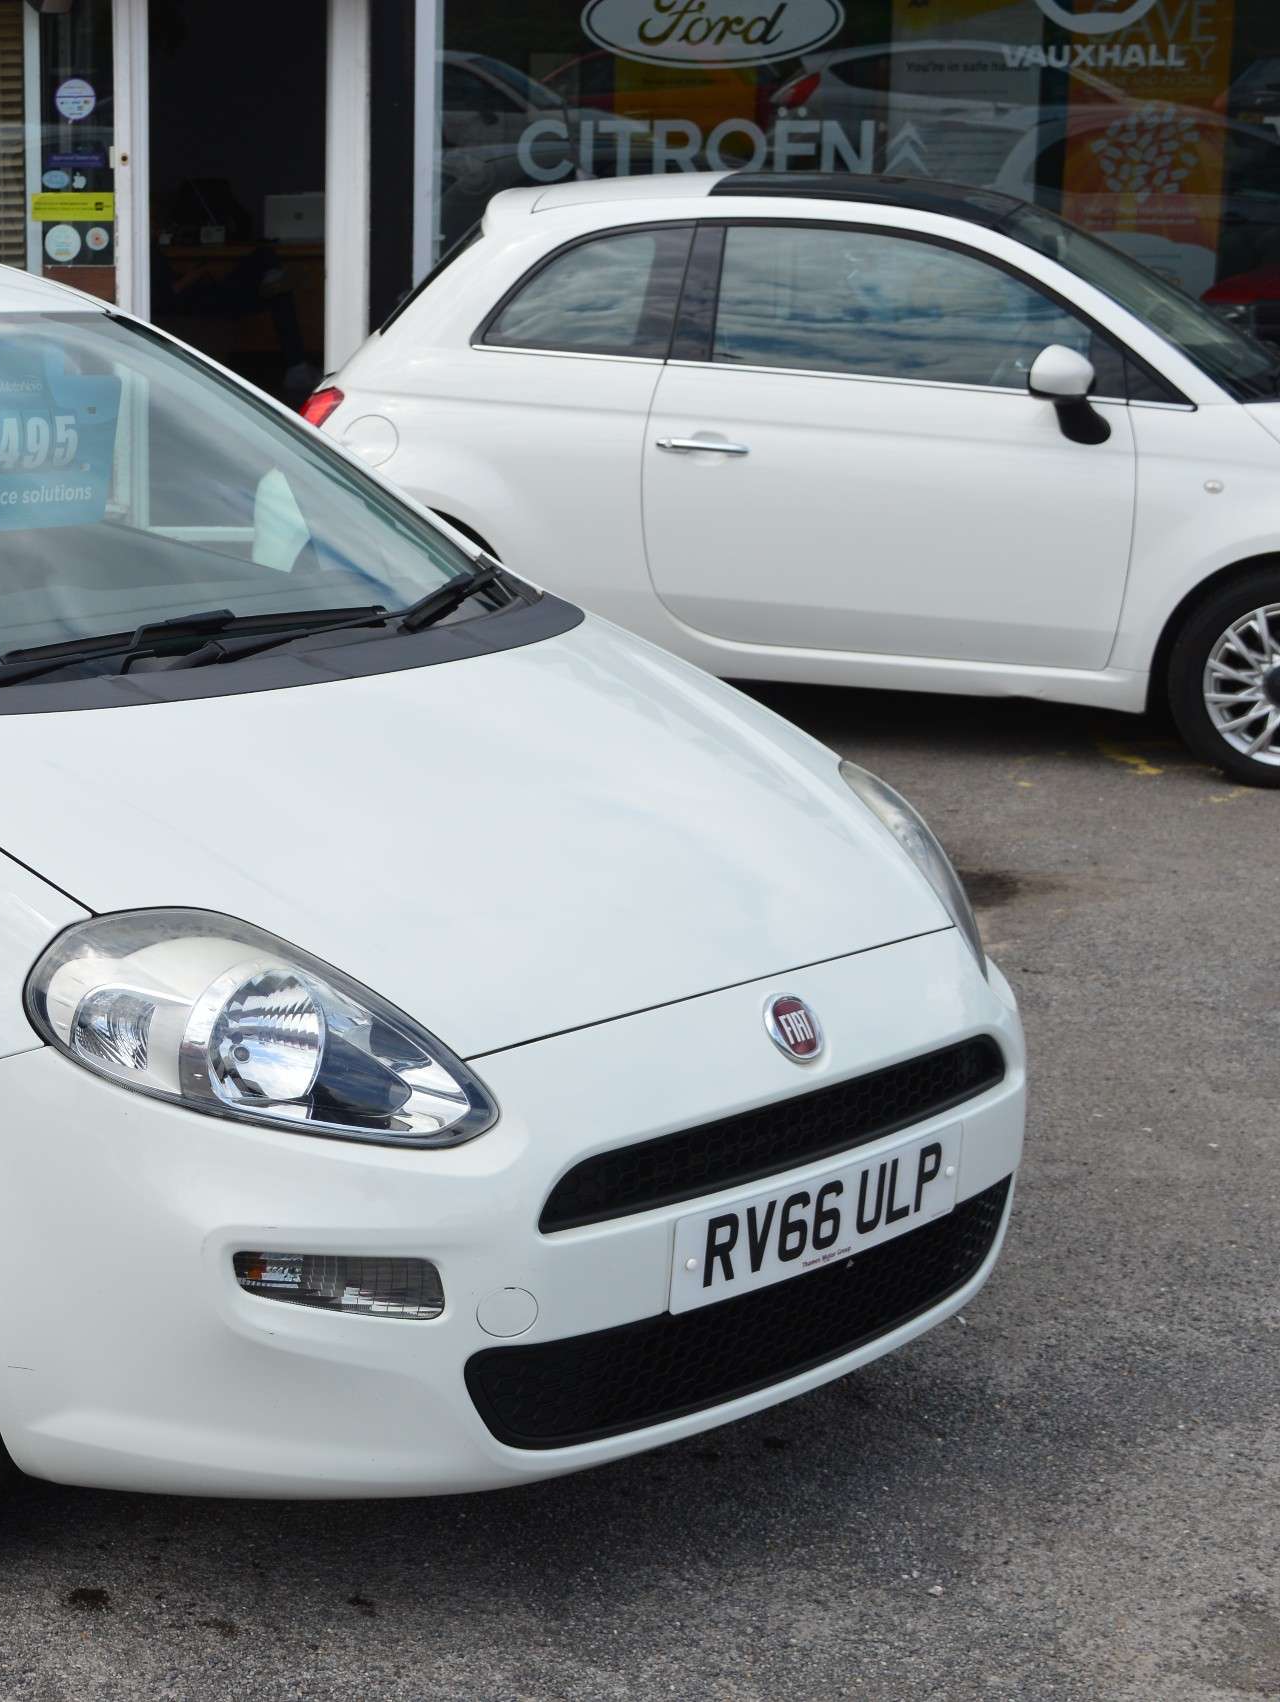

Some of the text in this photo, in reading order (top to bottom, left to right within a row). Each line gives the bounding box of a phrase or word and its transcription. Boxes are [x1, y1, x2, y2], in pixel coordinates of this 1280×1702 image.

[637, 0, 787, 46] Ford
[1001, 44, 1186, 67] VAUXHALL
[517, 106, 875, 181] CITROËN
[22, 484, 92, 503] solutions
[778, 1009, 814, 1045] FIAT
[702, 1142, 942, 1288] RV66 ULP
